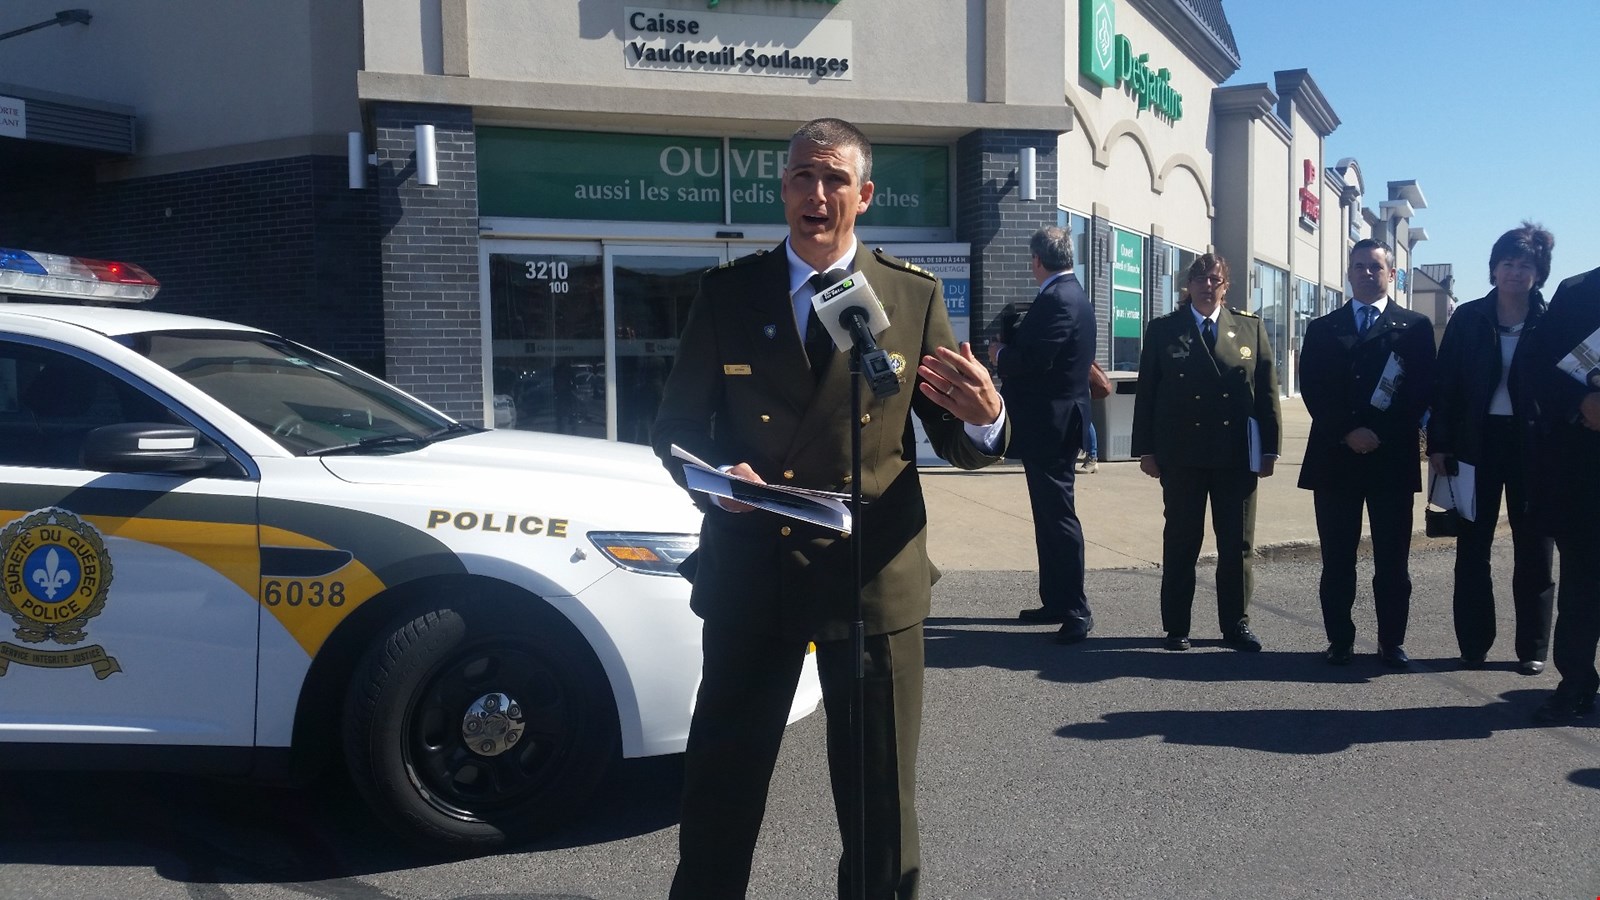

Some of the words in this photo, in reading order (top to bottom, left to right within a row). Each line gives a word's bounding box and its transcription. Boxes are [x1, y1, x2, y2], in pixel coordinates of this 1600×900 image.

[630, 12, 699, 35] Caisse
[631, 42, 849, 76] Vaudreuil-Soulanges
[1115, 33, 1184, 122] Desjardins
[575, 179, 631, 202] aussi
[640, 180, 669, 202] les
[678, 183, 775, 205] samedis
[870, 190, 920, 208] ches
[525, 261, 568, 280] 3210
[549, 282, 569, 294] 100
[949, 284, 966, 295] DU
[427, 509, 569, 538] POLICE
[5, 532, 35, 595] SÛRETÉ
[40, 529, 61, 542] DU
[68, 537, 97, 597] QUÉBEC
[264, 581, 345, 607] 6038
[21, 599, 80, 620] POLICE
[1, 645, 29, 661] SERVICE
[72, 648, 102, 663] JUSTICE
